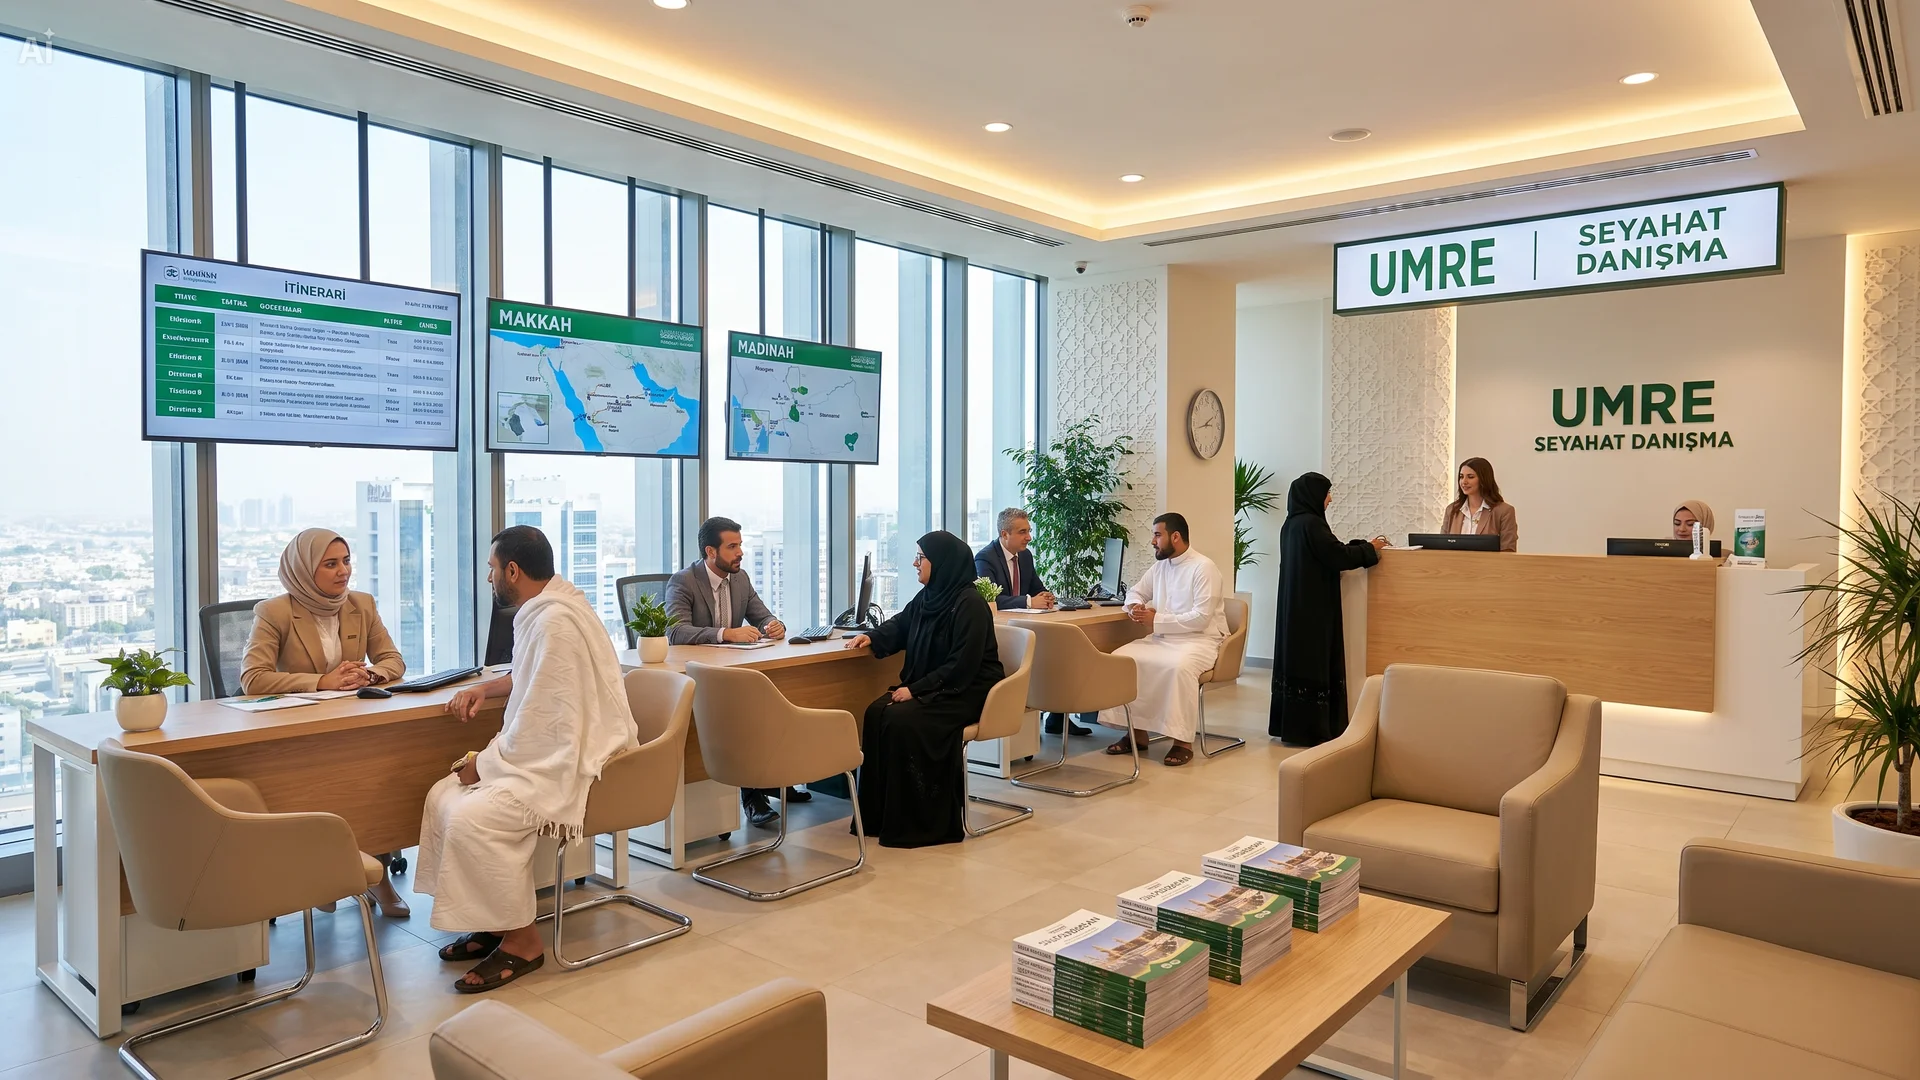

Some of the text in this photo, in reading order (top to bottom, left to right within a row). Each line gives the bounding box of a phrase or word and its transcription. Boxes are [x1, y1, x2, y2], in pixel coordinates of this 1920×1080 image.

[1578, 206, 1728, 247] SEYAHAT
[1369, 237, 1496, 297] UMRE
[1576, 237, 1728, 276] DANIŞMA
[284, 280, 346, 301] İTİNERARİ
[499, 309, 572, 333] MAKKAH
[738, 339, 794, 359] MADINAH
[1552, 380, 1715, 428] UMRE
[1533, 431, 1734, 453] SEYAHAT DANIŞMA
